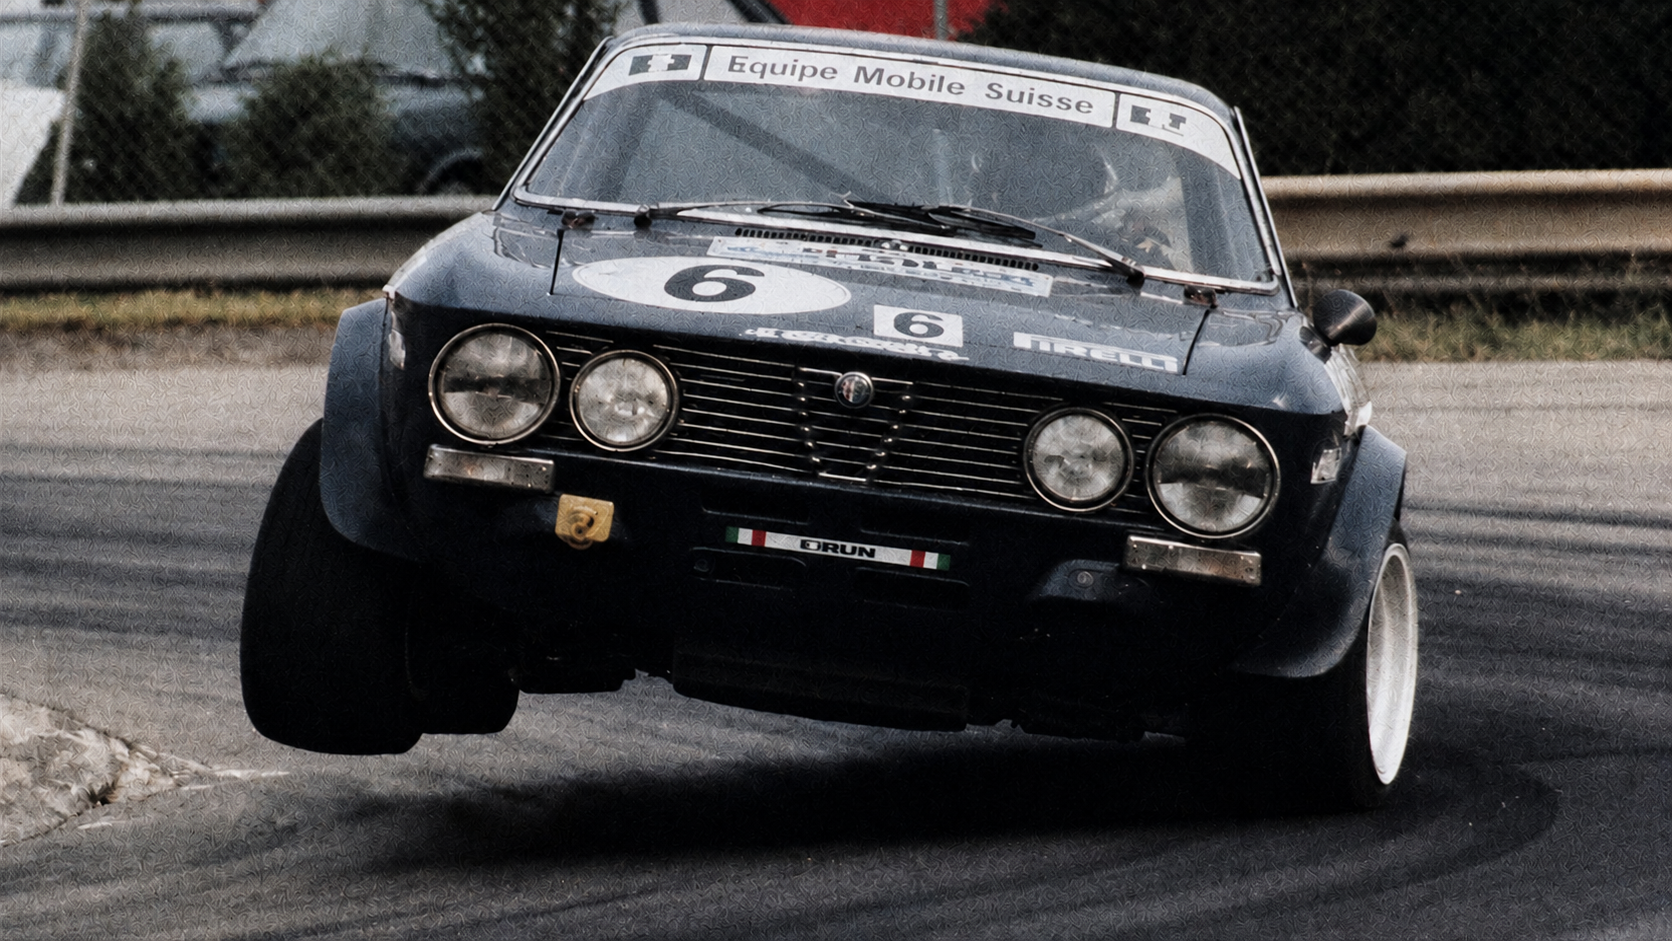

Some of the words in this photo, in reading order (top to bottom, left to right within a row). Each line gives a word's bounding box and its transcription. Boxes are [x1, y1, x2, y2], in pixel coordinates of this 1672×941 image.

[728, 55, 838, 82] Equipe
[854, 65, 966, 96] Mobile
[985, 82, 1094, 114] Suisse
[664, 265, 765, 302] 6
[893, 311, 945, 339] 6
